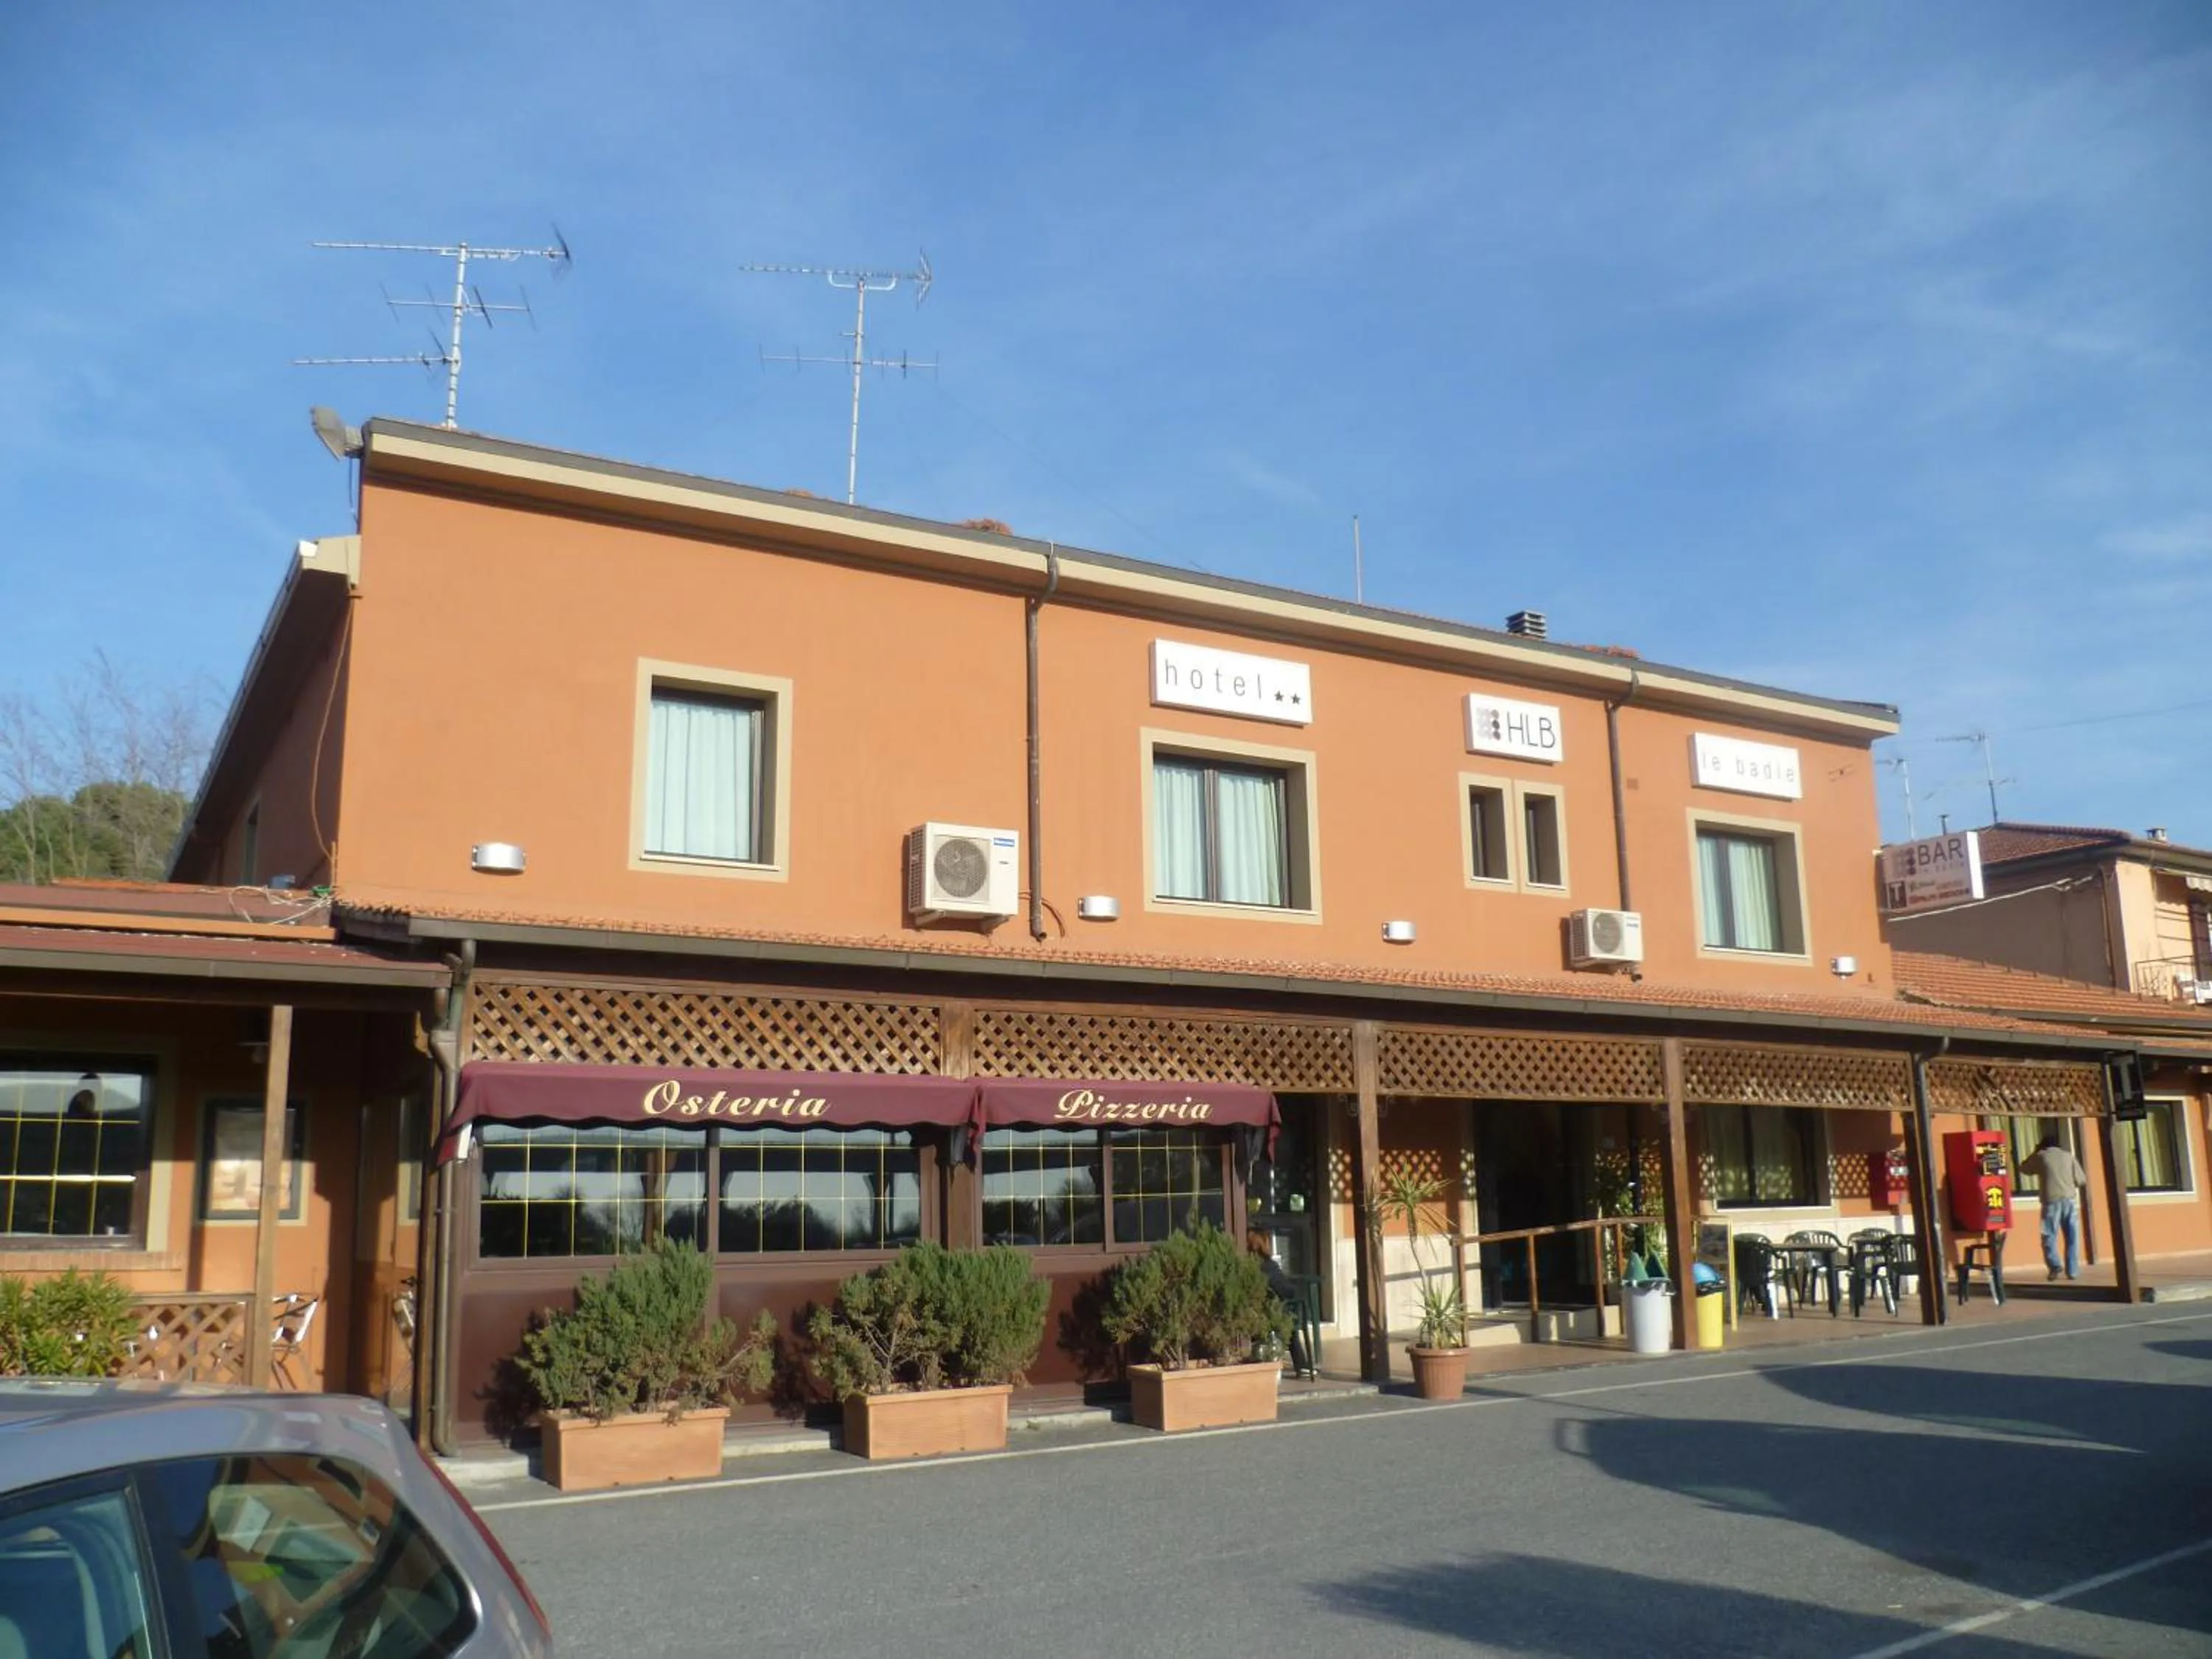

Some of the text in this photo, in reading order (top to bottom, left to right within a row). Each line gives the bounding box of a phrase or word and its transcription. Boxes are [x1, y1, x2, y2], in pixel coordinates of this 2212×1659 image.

[1164, 658, 1262, 700] hotel
[1506, 711, 1556, 748] HLB
[1702, 751, 1721, 772] le
[1917, 838, 1963, 866] BAR
[643, 1079, 830, 1116] Osteria
[1054, 1089, 1213, 1119] Pizzeria
